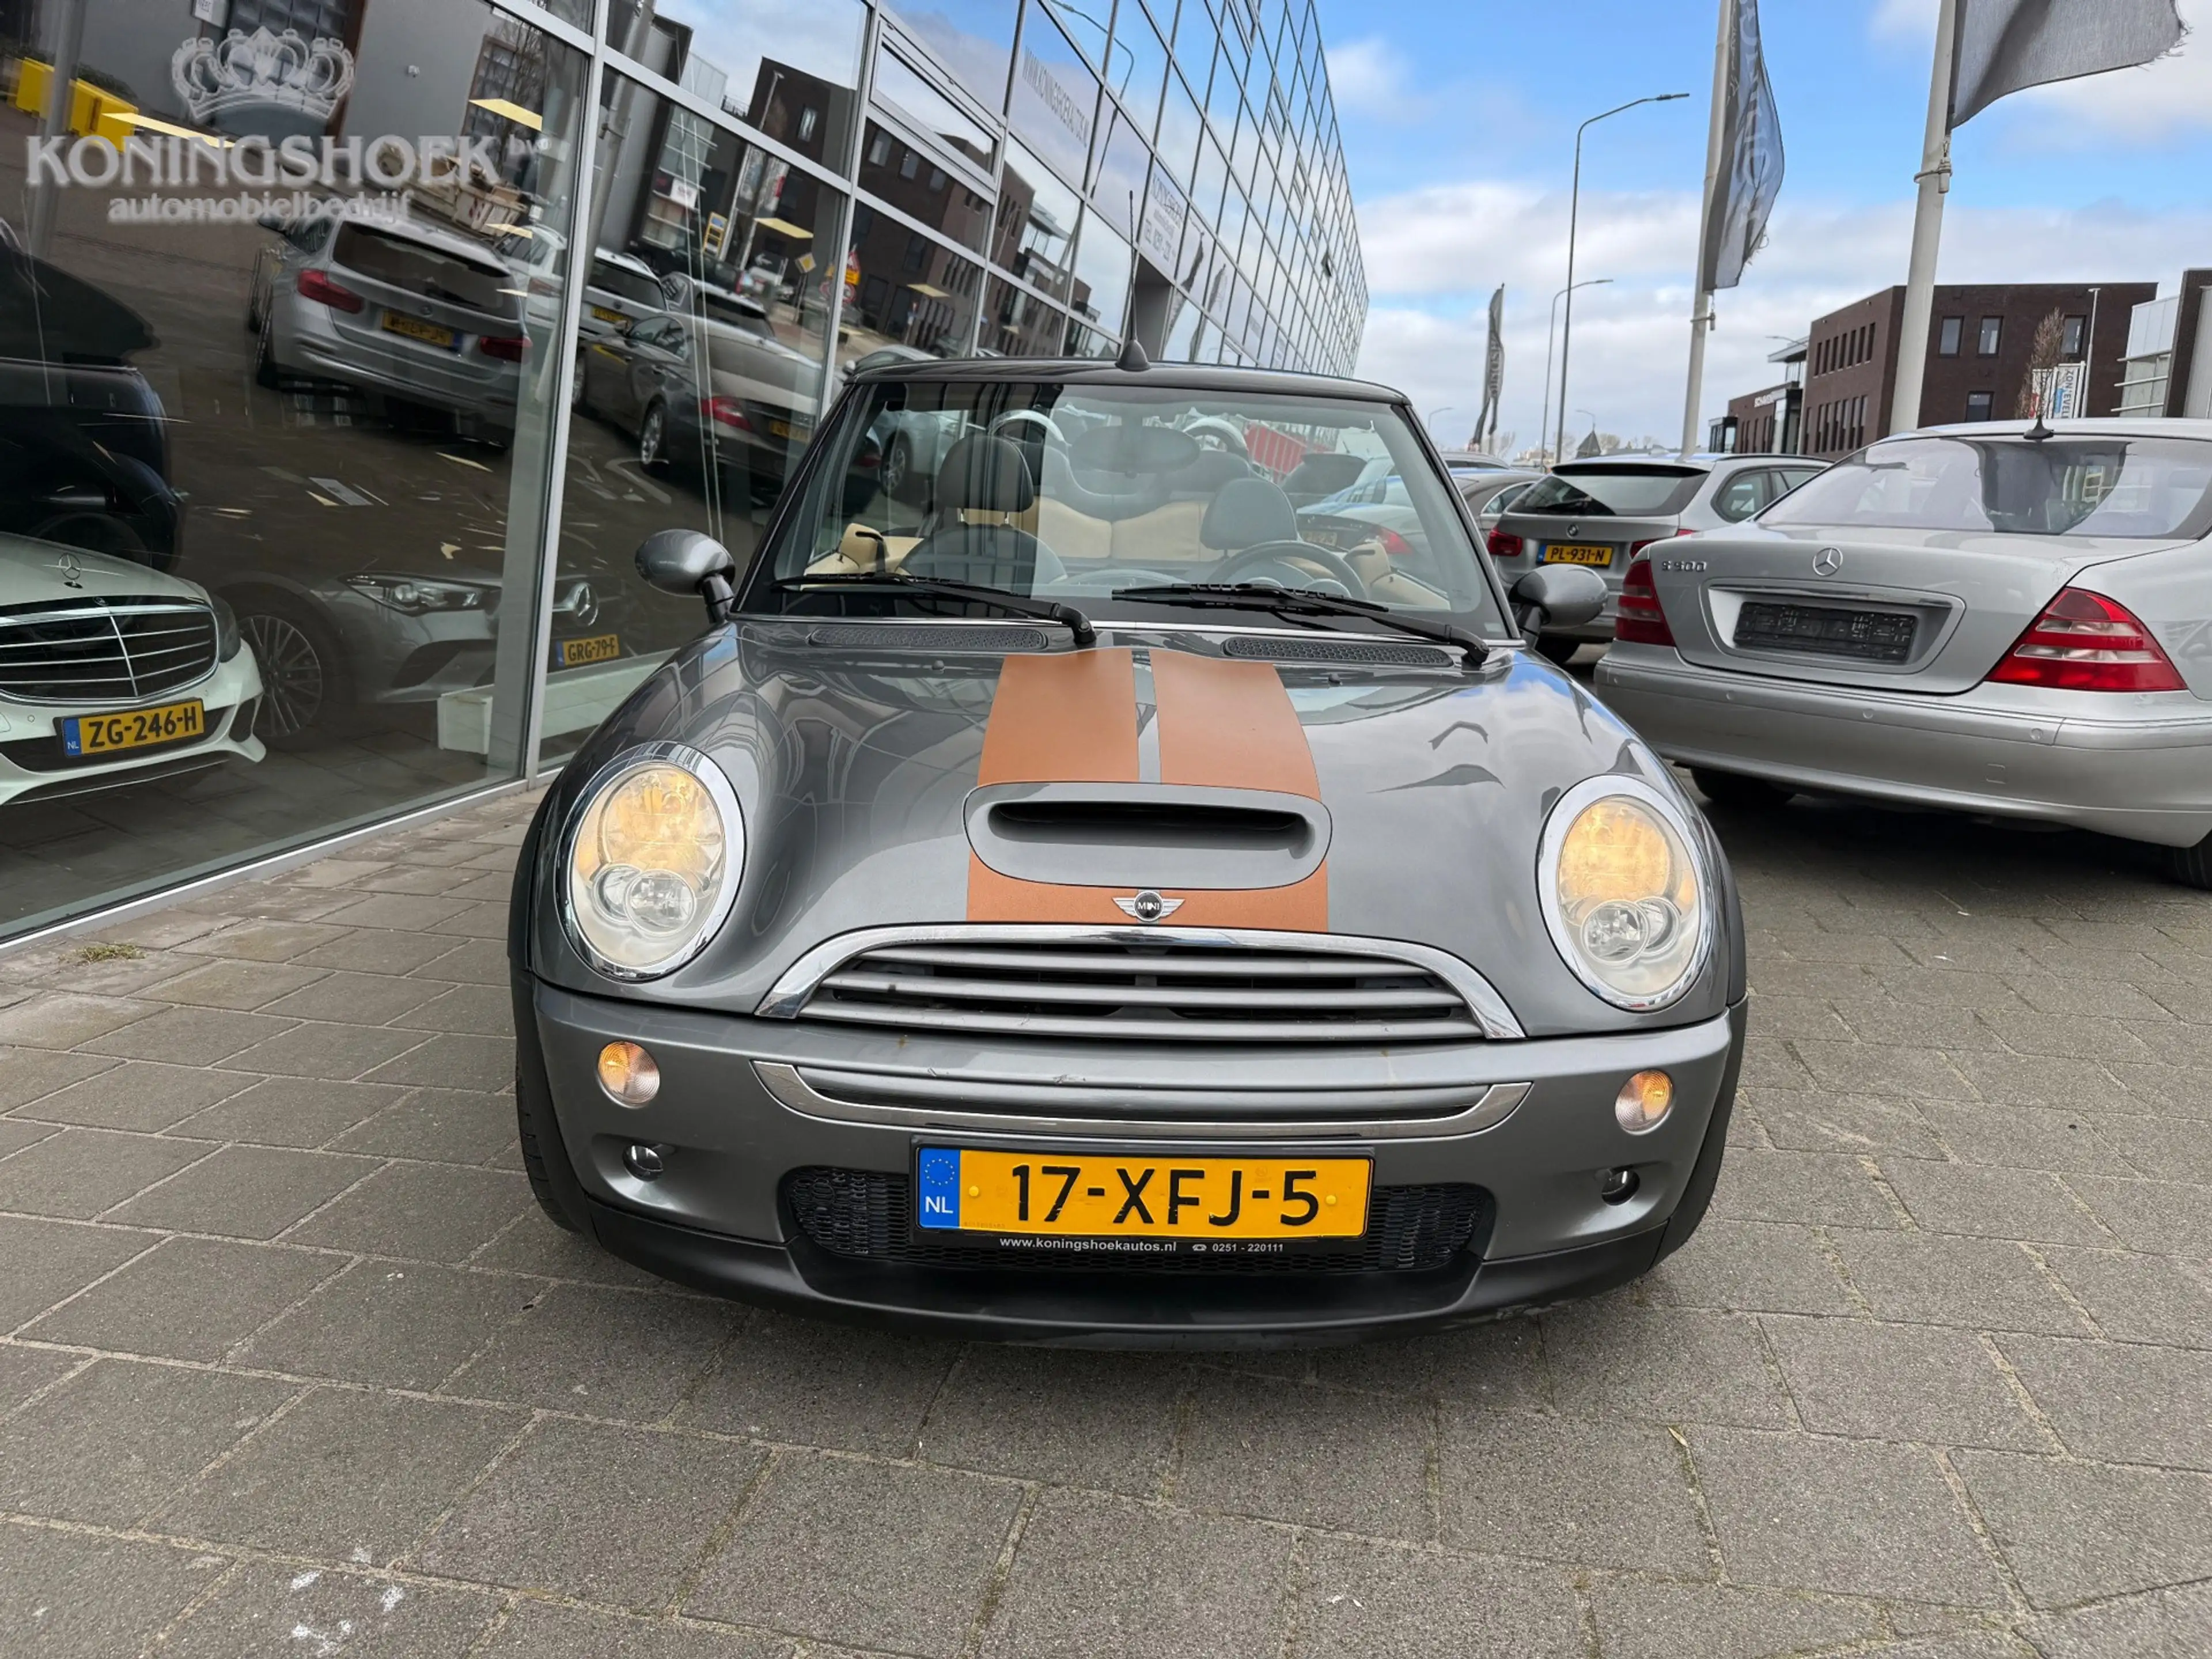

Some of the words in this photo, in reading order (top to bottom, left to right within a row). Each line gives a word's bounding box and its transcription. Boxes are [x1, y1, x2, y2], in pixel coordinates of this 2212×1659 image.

[1550, 547, 1605, 562] PL-931-N
[88, 706, 197, 748] ZG-246-H
[67, 740, 79, 749] NL
[1138, 902, 1160, 911] MINI
[1012, 1164, 1320, 1227] 17-XFJ-5
[925, 1196, 955, 1214] NL
[999, 1237, 1177, 1252] www.koningshoekautos.nl
[1212, 1243, 1237, 1252] 0251
[1247, 1244, 1284, 1252] 220111
